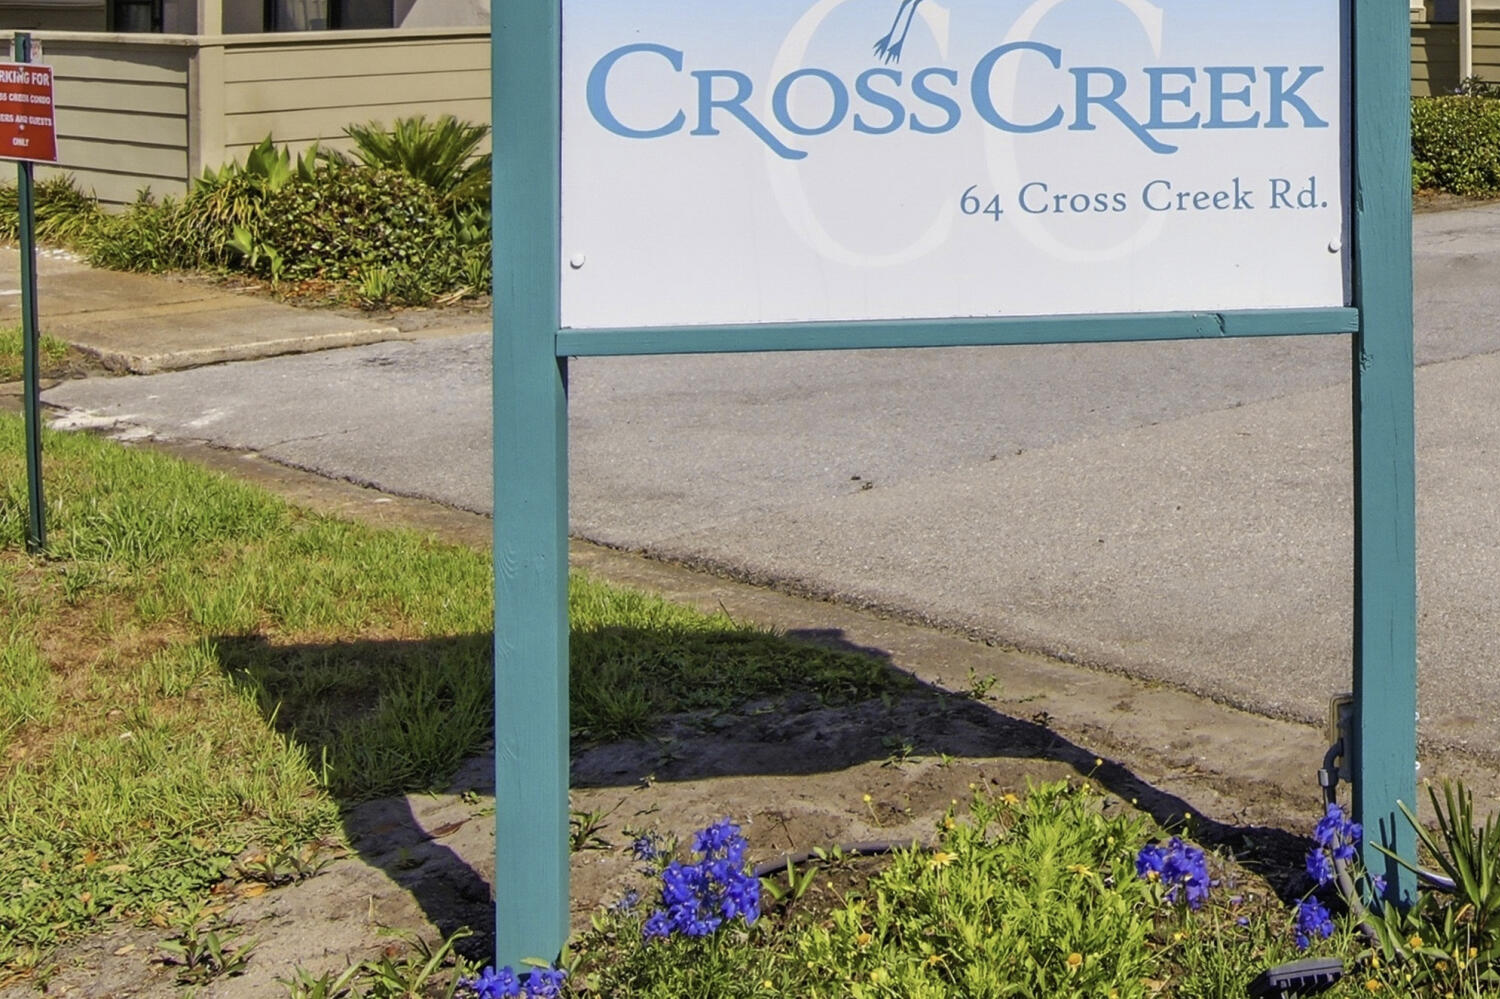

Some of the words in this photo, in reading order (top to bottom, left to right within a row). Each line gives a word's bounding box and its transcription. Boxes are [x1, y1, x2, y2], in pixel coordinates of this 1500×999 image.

[31, 73, 50, 86] FOR
[12, 137, 29, 147] ONLY
[959, 184, 1005, 222] 64
[1019, 181, 1127, 215] Cross
[1141, 178, 1254, 213] Creek
[1268, 176, 1329, 211] Rd.
